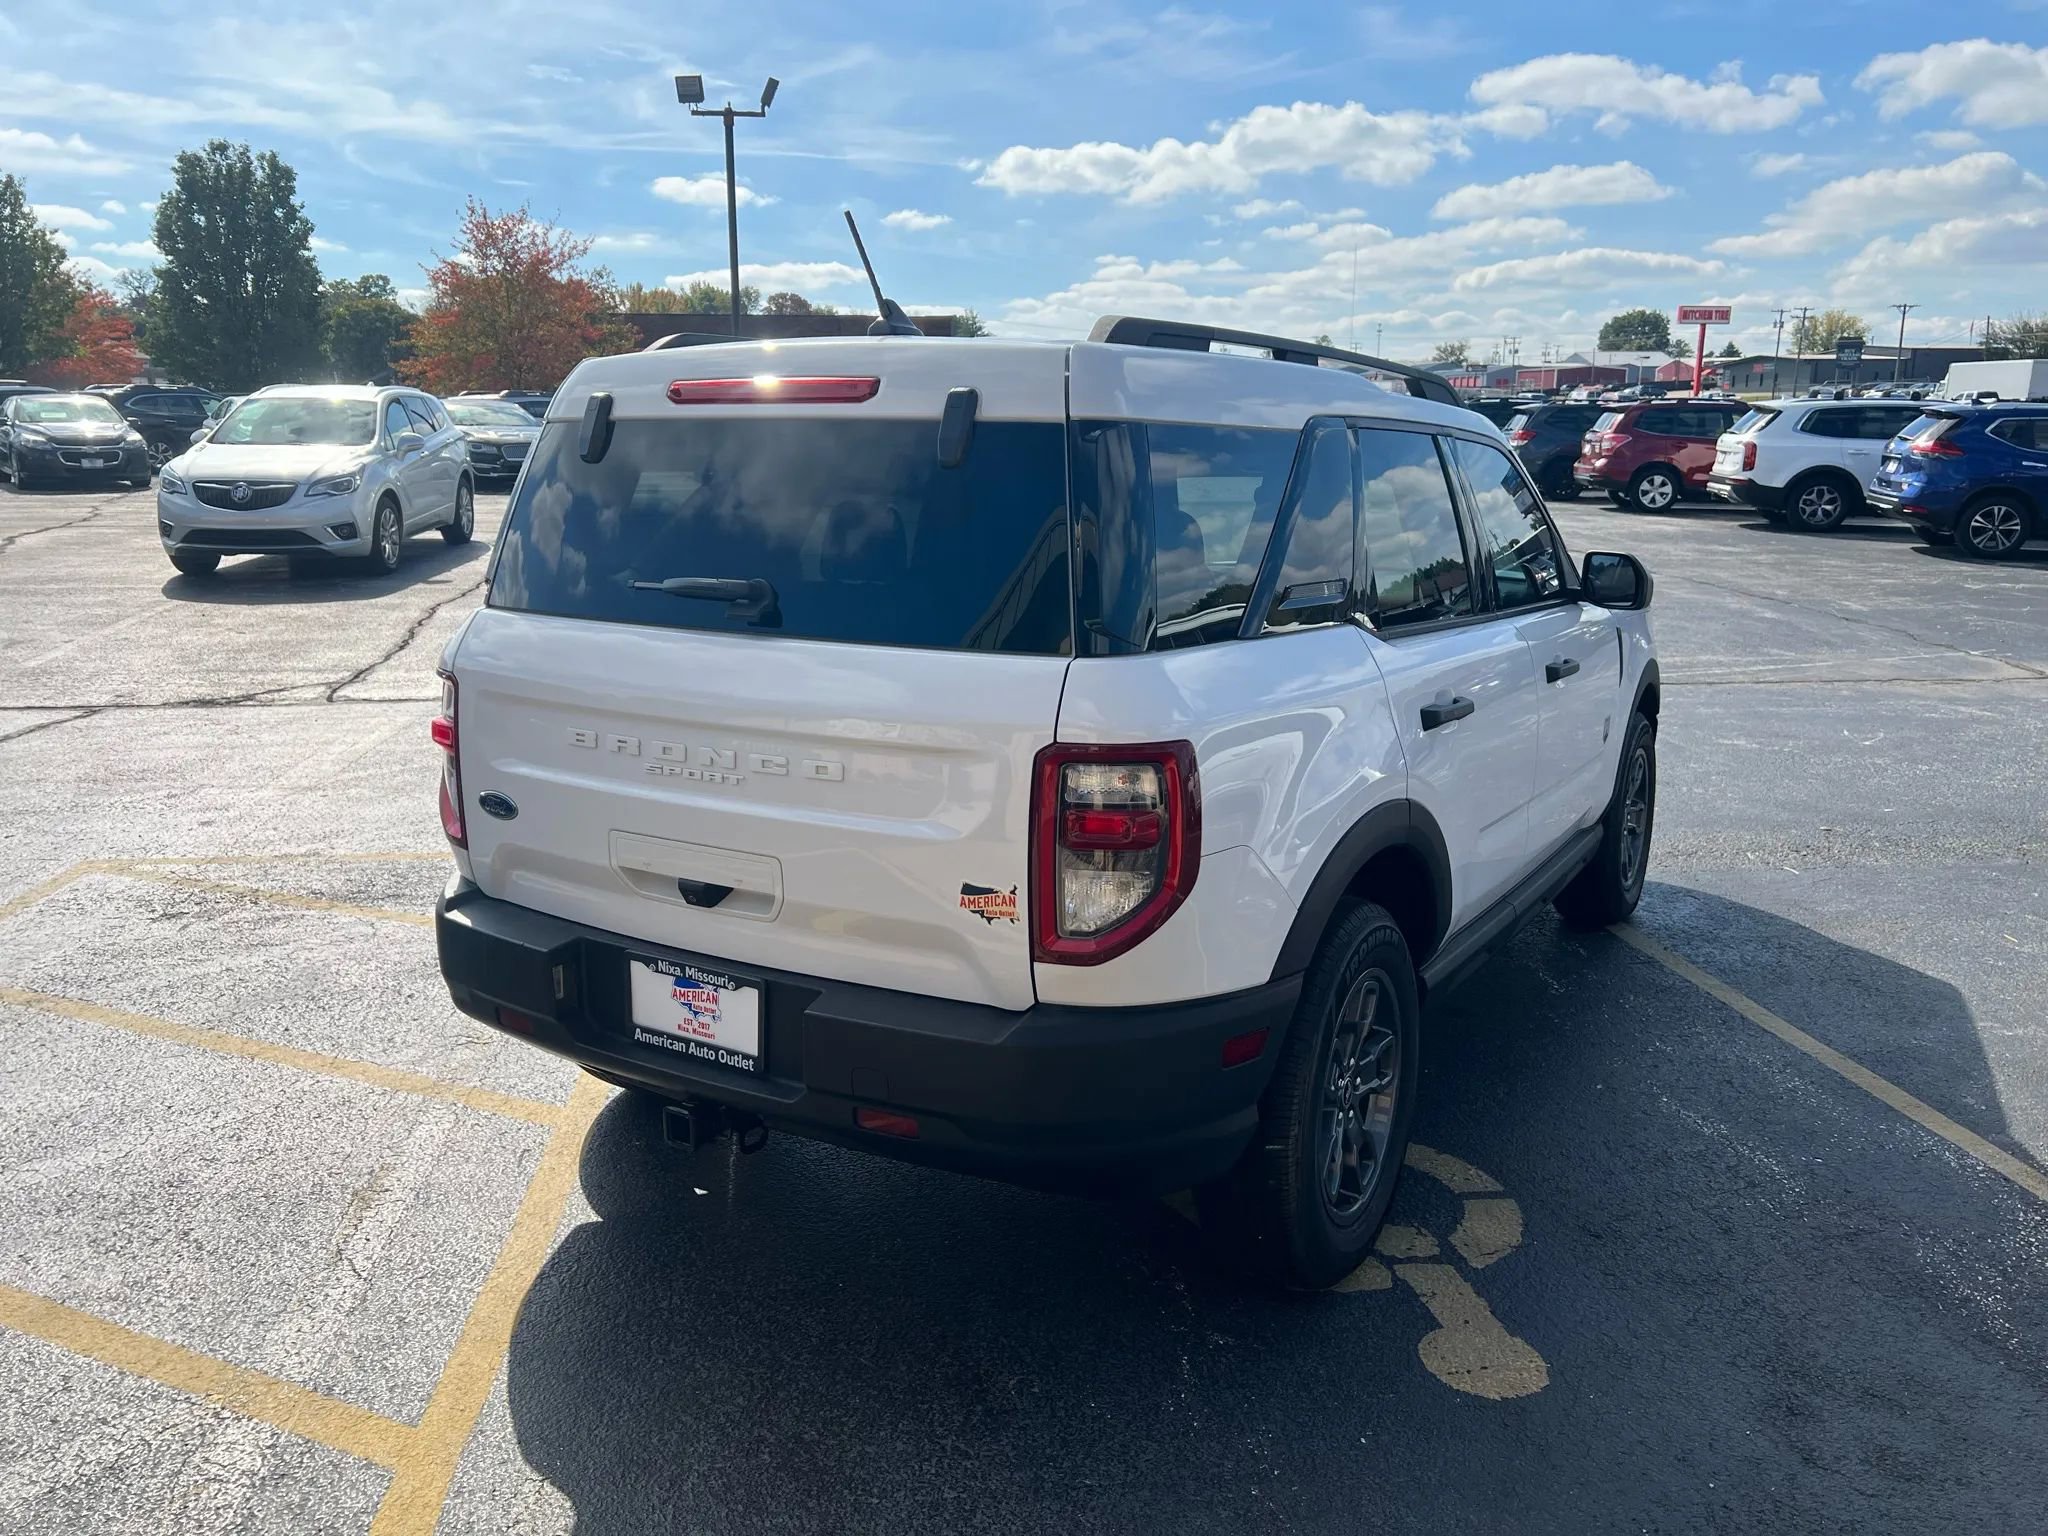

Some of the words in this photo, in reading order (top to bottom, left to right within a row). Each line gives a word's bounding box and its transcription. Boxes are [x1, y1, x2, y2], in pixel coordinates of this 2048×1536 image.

[1714, 309, 1729, 320] TIRE
[567, 726, 845, 783] BRONCO
[644, 762, 746, 786] SPORT
[960, 894, 1016, 909] AMERICAN
[1345, 928, 1400, 986] IRONMAN
[657, 960, 683, 977] Nixa,
[685, 966, 729, 988] Missouri
[672, 989, 718, 1006] AMERICAN
[692, 1027, 716, 1040] Missouri
[697, 1021, 711, 1031] 2017
[634, 1028, 686, 1053] American
[688, 1042, 716, 1060] Auto
[718, 1049, 755, 1072] Outlet
